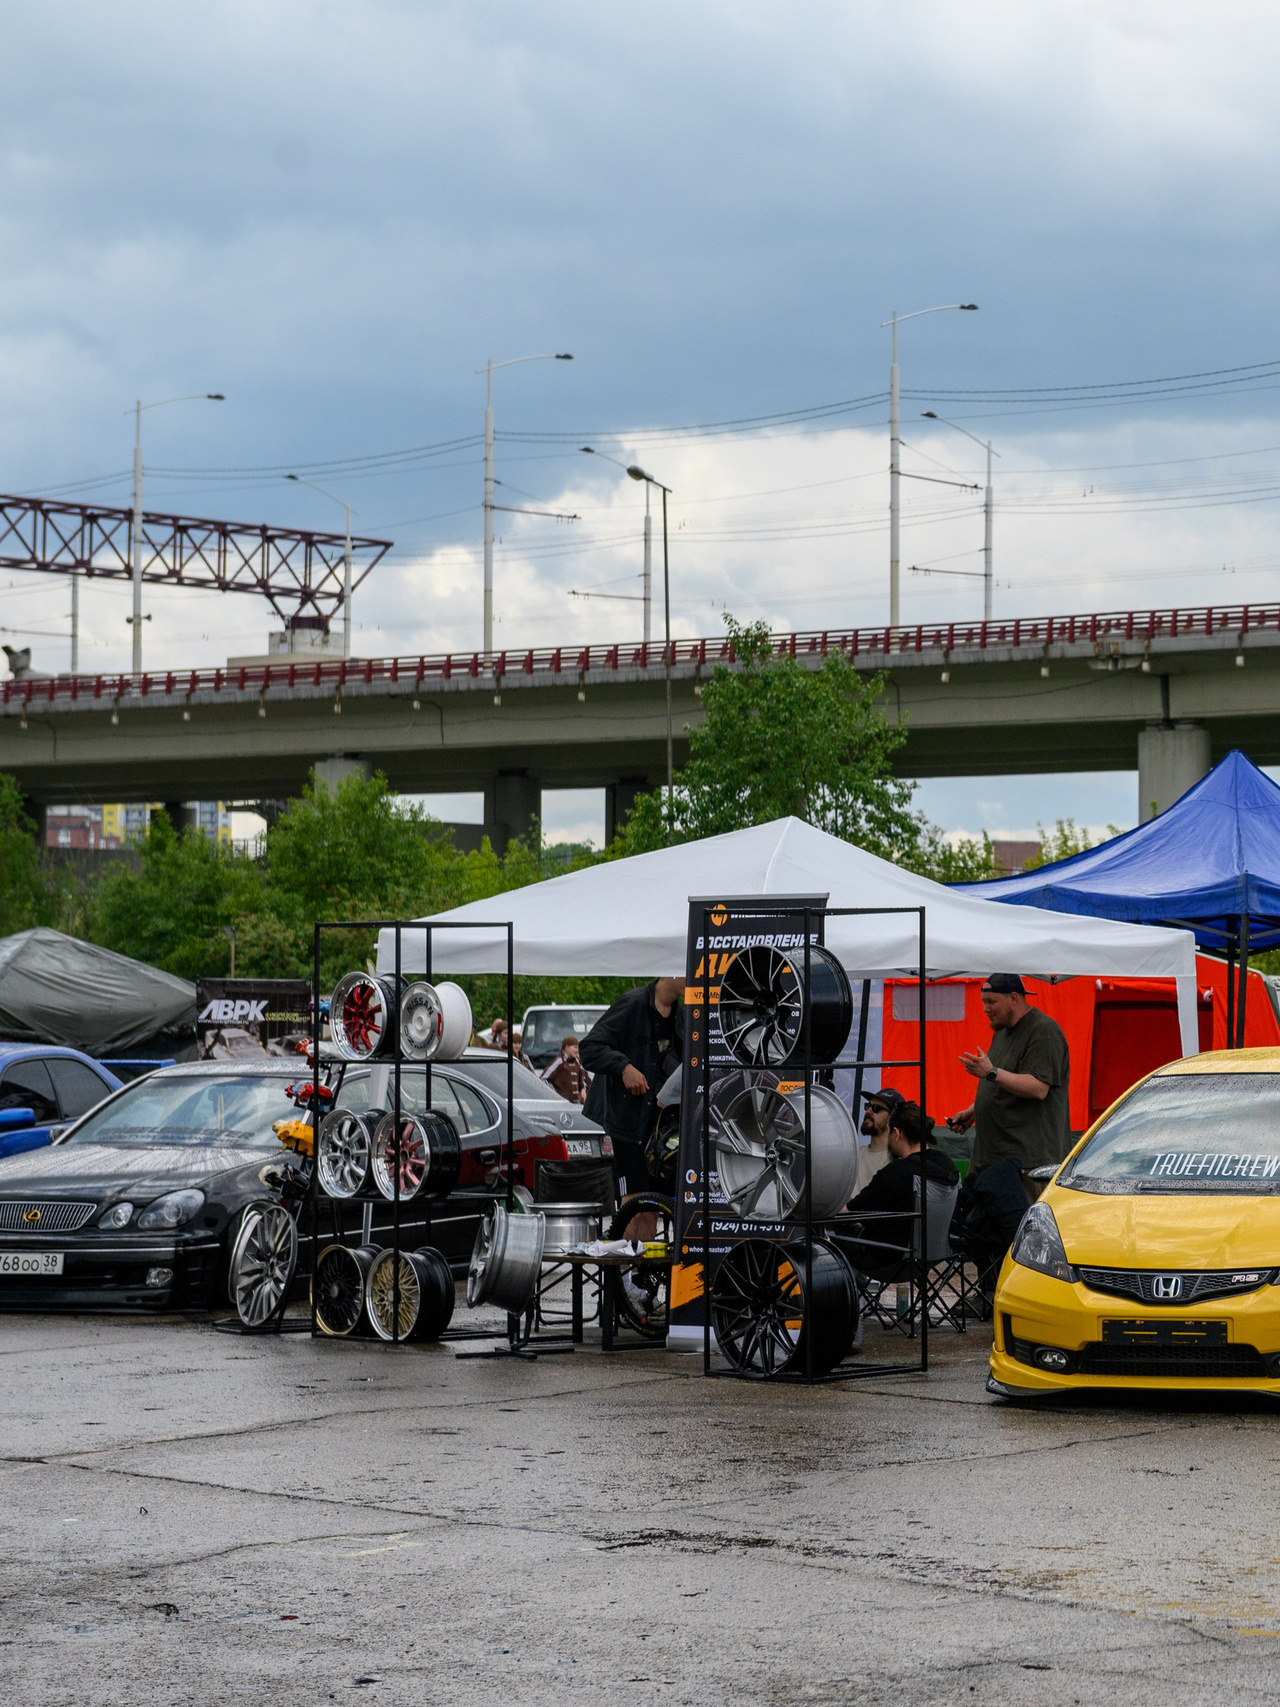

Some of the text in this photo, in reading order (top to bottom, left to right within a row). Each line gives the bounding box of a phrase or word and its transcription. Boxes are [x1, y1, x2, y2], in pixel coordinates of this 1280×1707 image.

[406, 997, 434, 1015] NISSAN
[579, 1141, 589, 1151] 95
[43, 1255, 58, 1267] 38
[1231, 1274, 1259, 1283] RS
